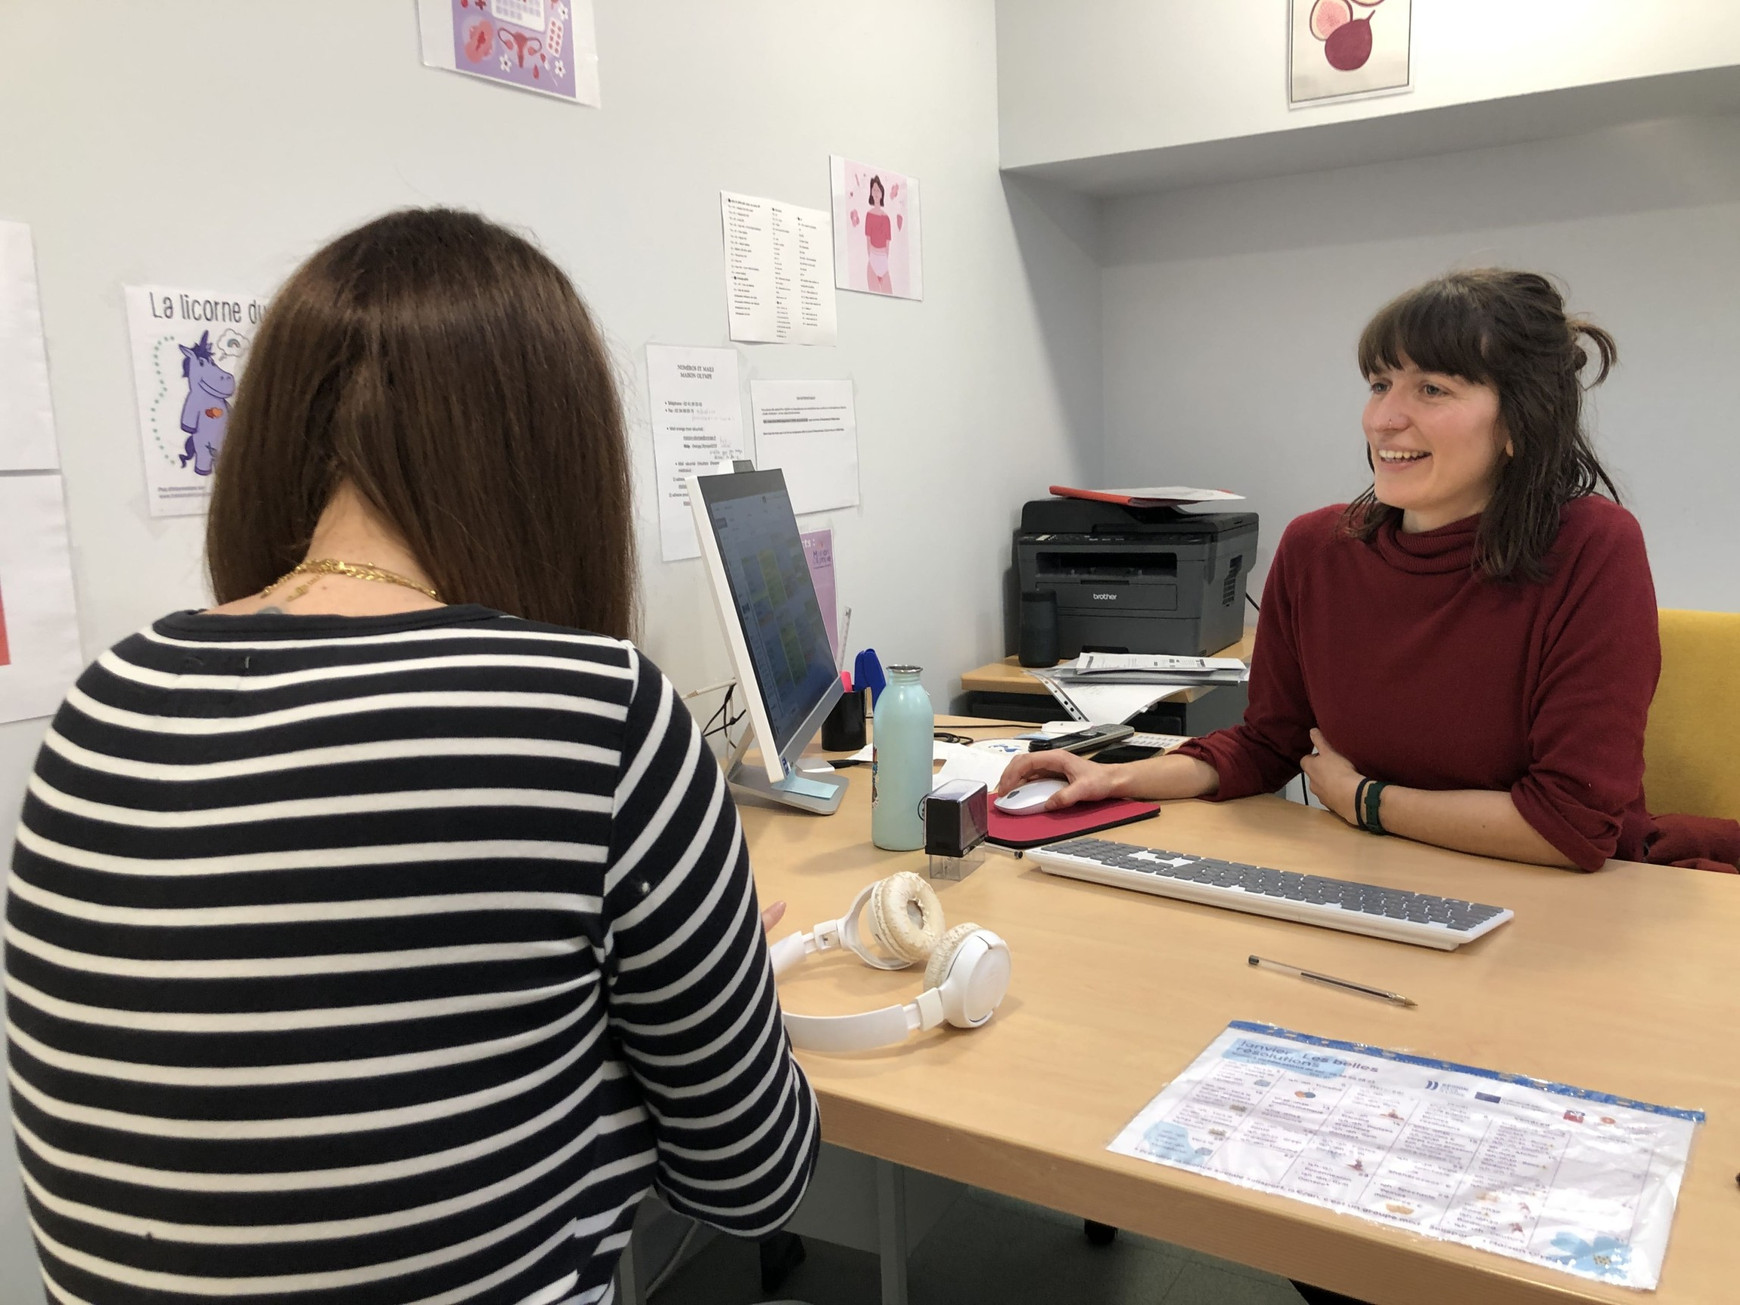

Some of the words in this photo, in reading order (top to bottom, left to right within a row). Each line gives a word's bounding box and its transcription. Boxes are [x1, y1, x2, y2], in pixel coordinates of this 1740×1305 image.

[149, 291, 174, 319] La
[180, 294, 242, 323] licorne
[1302, 1053, 1329, 1063] Les
[1333, 1058, 1379, 1073] belles
